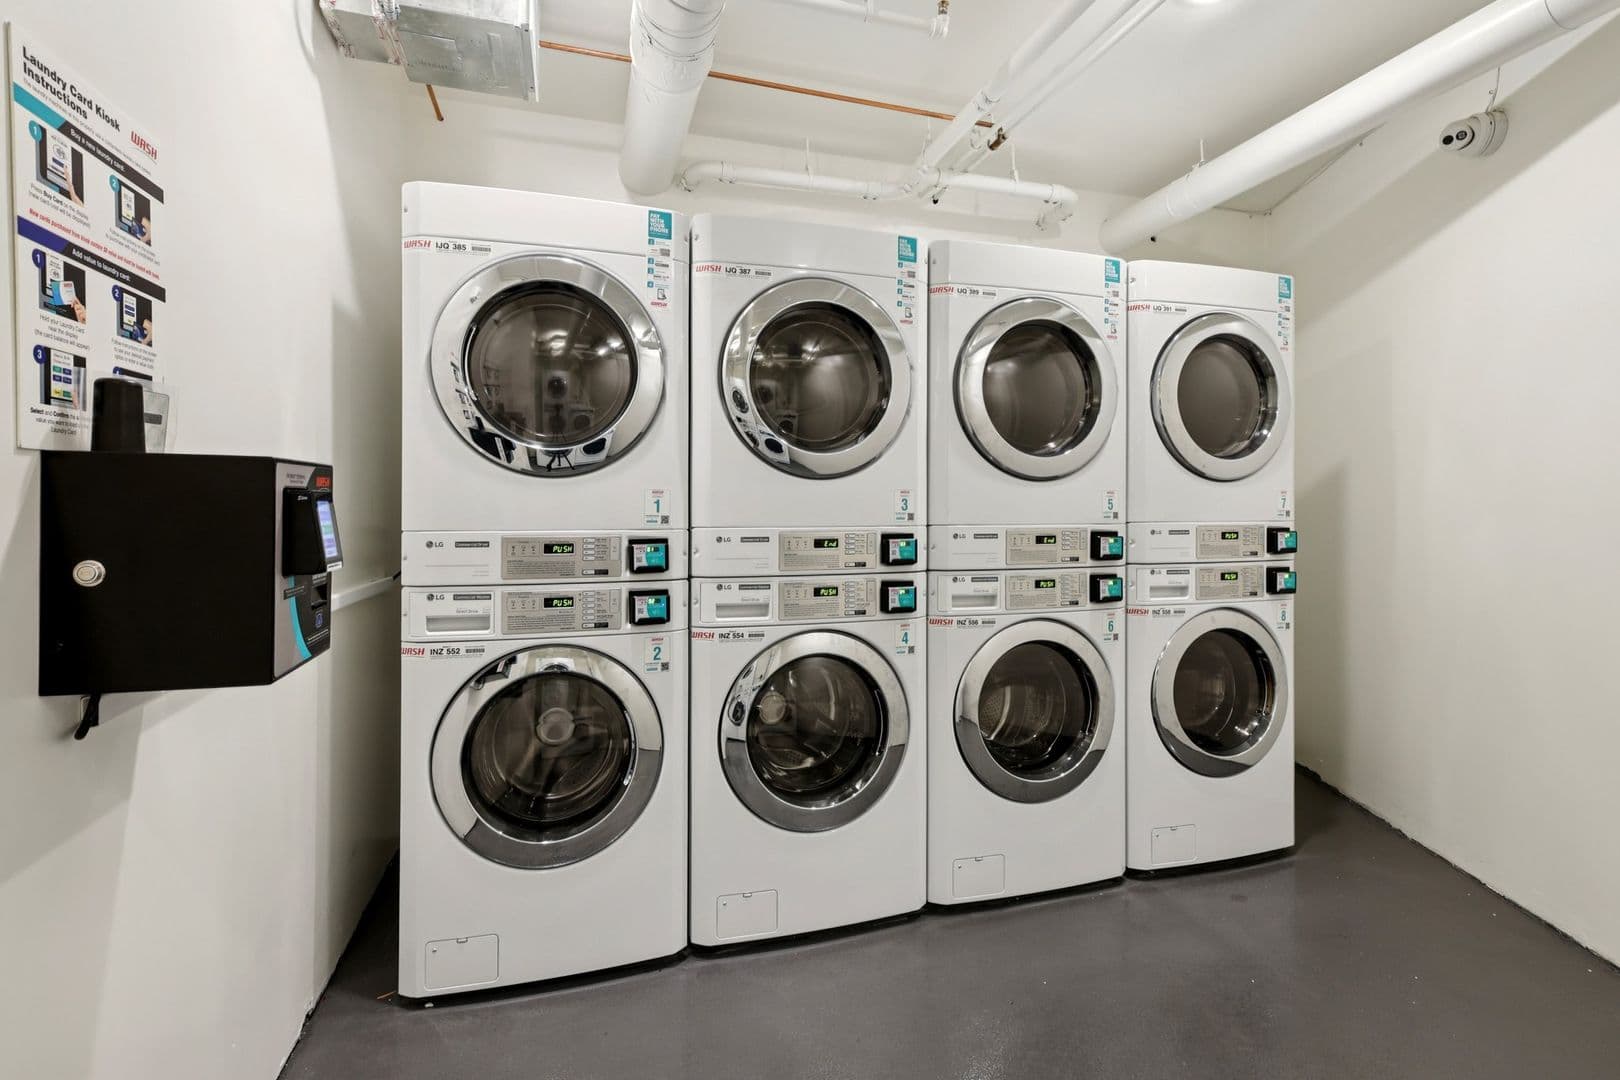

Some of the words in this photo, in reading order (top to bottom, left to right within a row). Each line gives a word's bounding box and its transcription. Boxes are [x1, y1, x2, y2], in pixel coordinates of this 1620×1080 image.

[22, 45, 66, 92] Laundry
[69, 82, 92, 111] Card
[95, 102, 120, 133] Kiosk
[23, 61, 87, 120] Instructions
[33, 126, 38, 135] 1
[130, 129, 157, 161] WASH
[404, 240, 431, 249] WASH
[435, 242, 449, 250] IJQ
[452, 243, 467, 251] 385
[72, 247, 83, 259] Add
[83, 253, 96, 266] value
[96, 259, 102, 268] to
[102, 262, 119, 277] laundry
[696, 264, 722, 272] WASH
[114, 289, 119, 298] 2
[36, 349, 42, 359] 3
[653, 499, 660, 513] 1
[901, 498, 908, 511] 3
[1108, 499, 1113, 510] 5
[1281, 498, 1286, 508] 7
[553, 545, 572, 553] PUSH
[820, 588, 837, 596] PUSH
[553, 599, 572, 607] PUSH
[1281, 610, 1286, 621] 8
[1108, 620, 1113, 632] 6
[691, 631, 714, 639] WASH
[902, 632, 908, 644] 4
[401, 647, 425, 656] WASH
[446, 647, 460, 655] 552
[653, 647, 661, 660] 2
